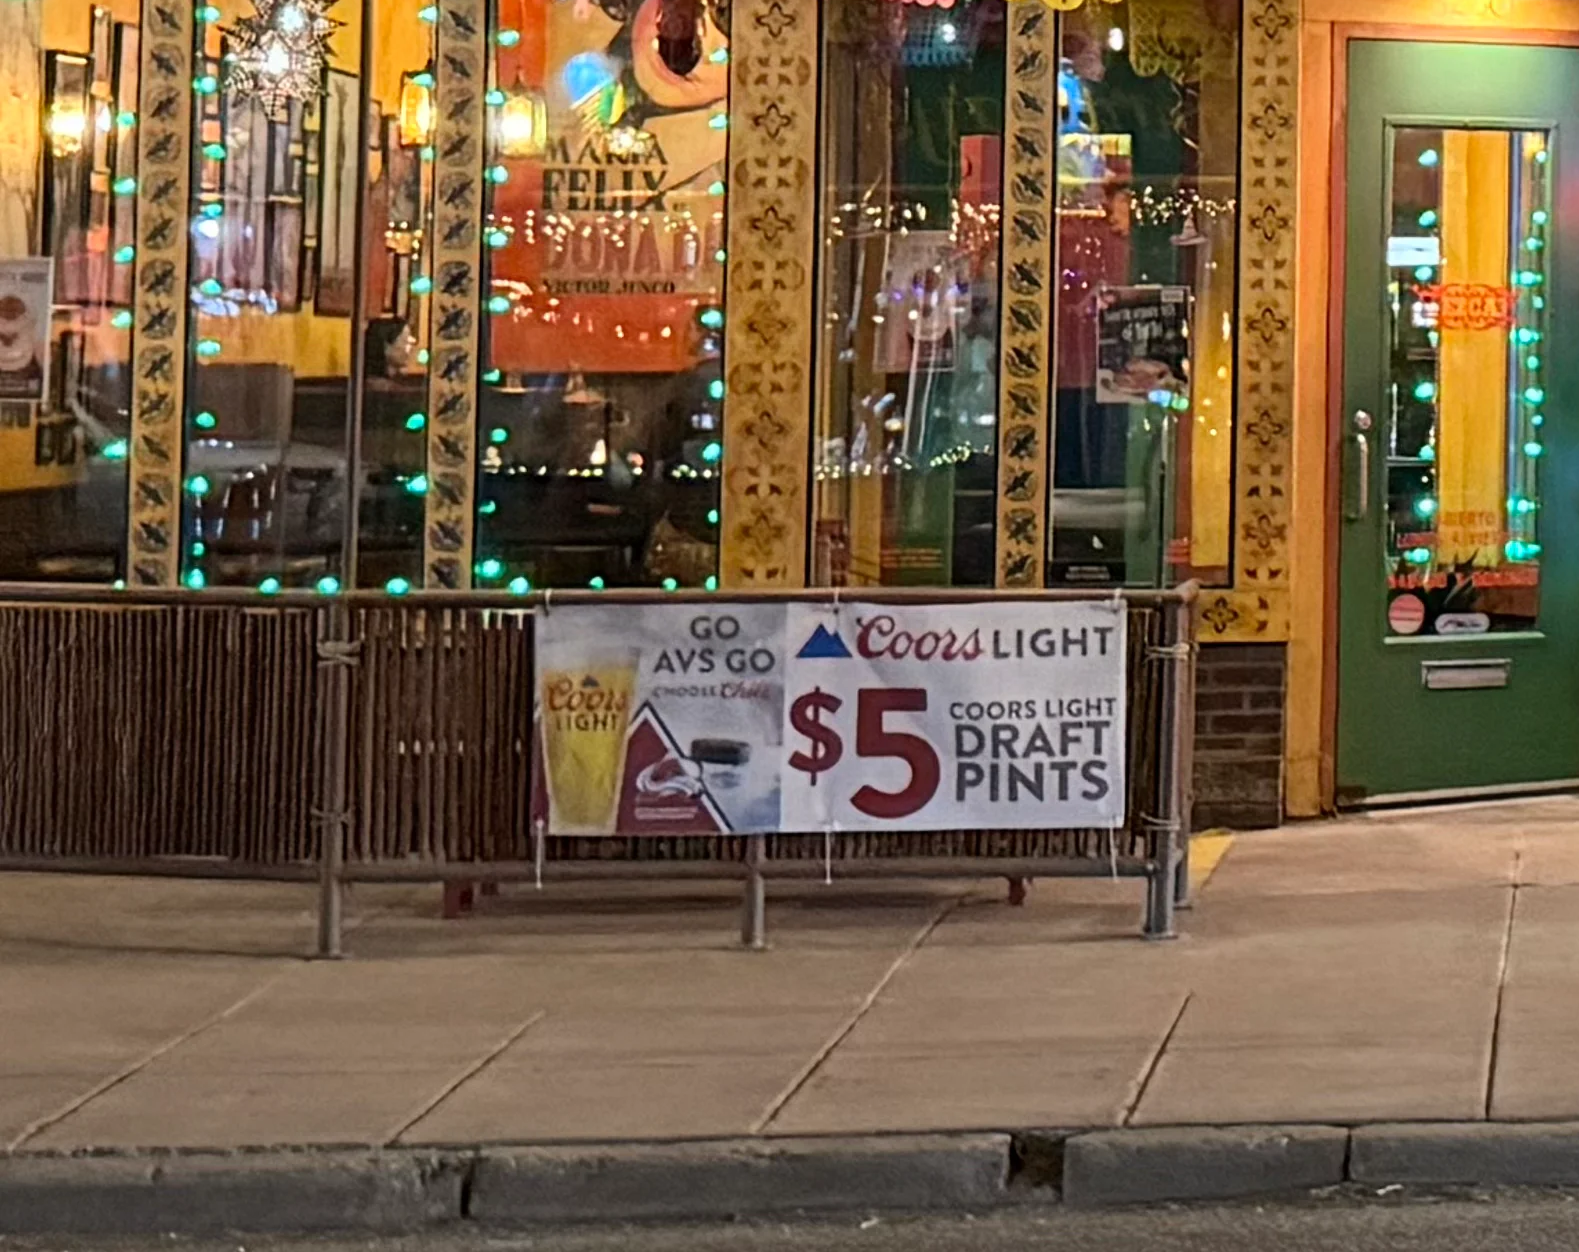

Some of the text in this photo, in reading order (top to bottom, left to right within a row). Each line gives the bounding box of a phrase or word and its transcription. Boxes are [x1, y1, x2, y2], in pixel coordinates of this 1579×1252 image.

[543, 168, 668, 212] FELIX
[690, 615, 740, 641] GO
[856, 615, 1114, 662] Coors LIGHT
[652, 648, 776, 674] AVS GO
[949, 697, 1117, 722] COORS LIGHT
[787, 685, 941, 820] $5
[955, 719, 1111, 760] DRAFT
[955, 759, 1110, 803] PINTS
